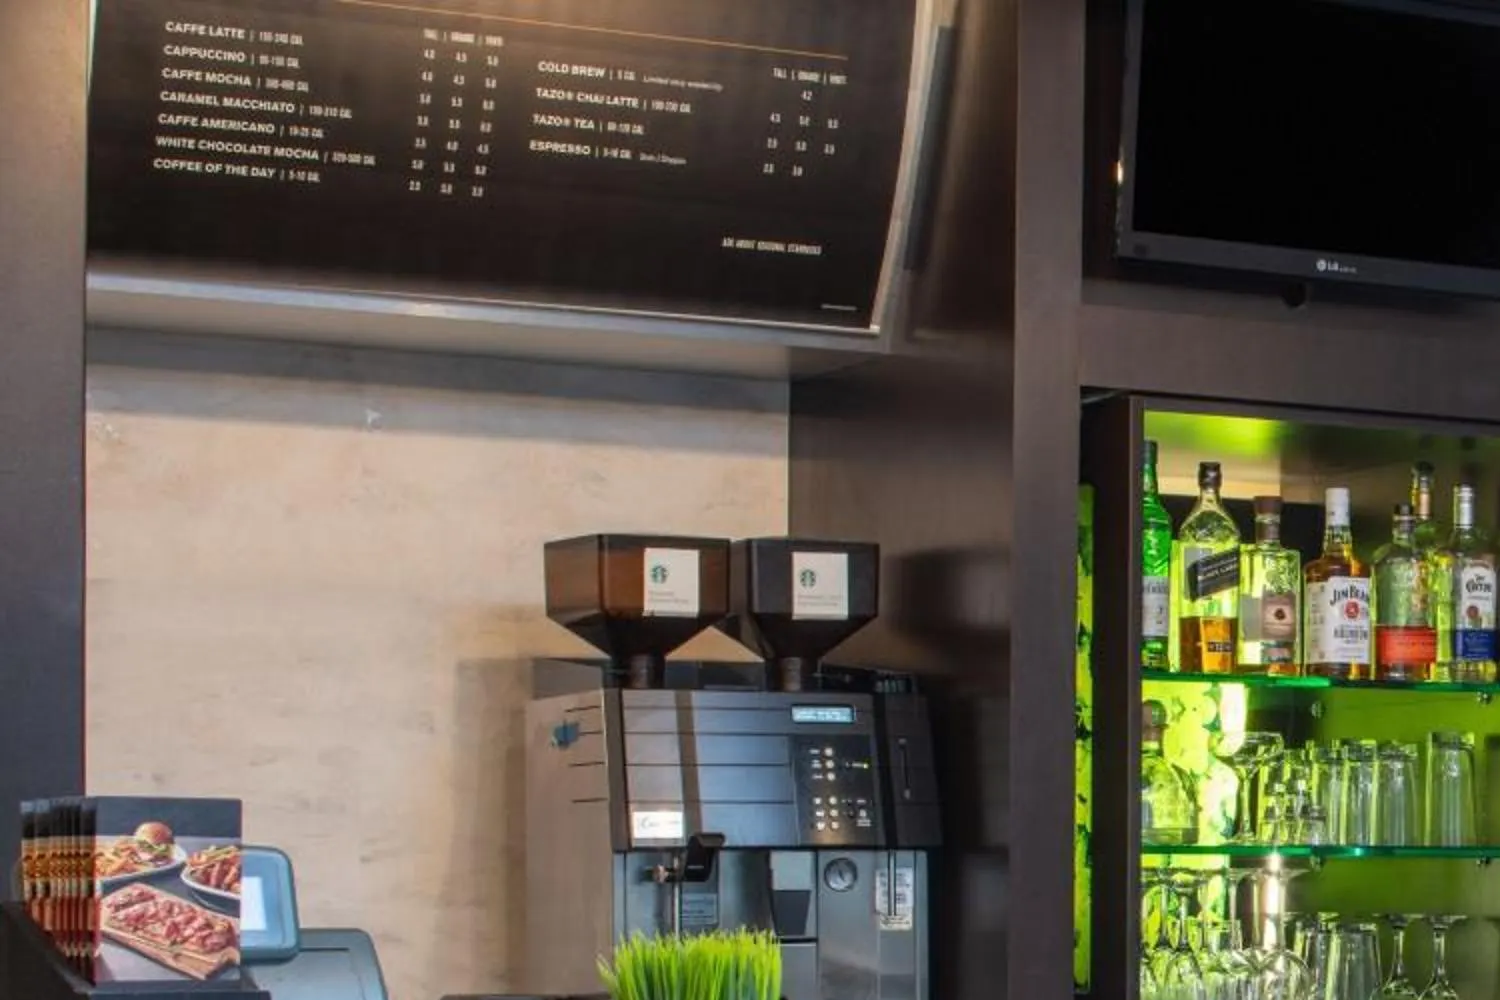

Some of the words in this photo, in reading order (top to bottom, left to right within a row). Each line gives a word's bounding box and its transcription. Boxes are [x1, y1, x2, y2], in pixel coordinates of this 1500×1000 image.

[165, 21, 206, 35] CAFFE
[209, 25, 246, 39] LATTE
[163, 44, 246, 63] CAPPUCCINO
[161, 67, 202, 81] CAFFE
[205, 71, 252, 87] MOCHA
[537, 60, 569, 74] COLD
[571, 64, 606, 79] BREW
[160, 91, 219, 107] CARAMEL
[222, 96, 296, 114] MACCHIATO
[576, 91, 604, 105] CHAI
[605, 94, 640, 109] LATTE
[157, 113, 199, 127] CAFFE
[201, 117, 276, 134] AMERICANO
[574, 117, 596, 131] TEA
[155, 135, 196, 150] WHITE
[197, 138, 271, 155] CHOCOLATE
[273, 147, 320, 161] MOCHA
[529, 139, 591, 156] ESPRESSO
[153, 157, 203, 172] COFFEE
[205, 161, 223, 174] OF
[224, 164, 248, 176] THE
[251, 167, 276, 180] DAY
